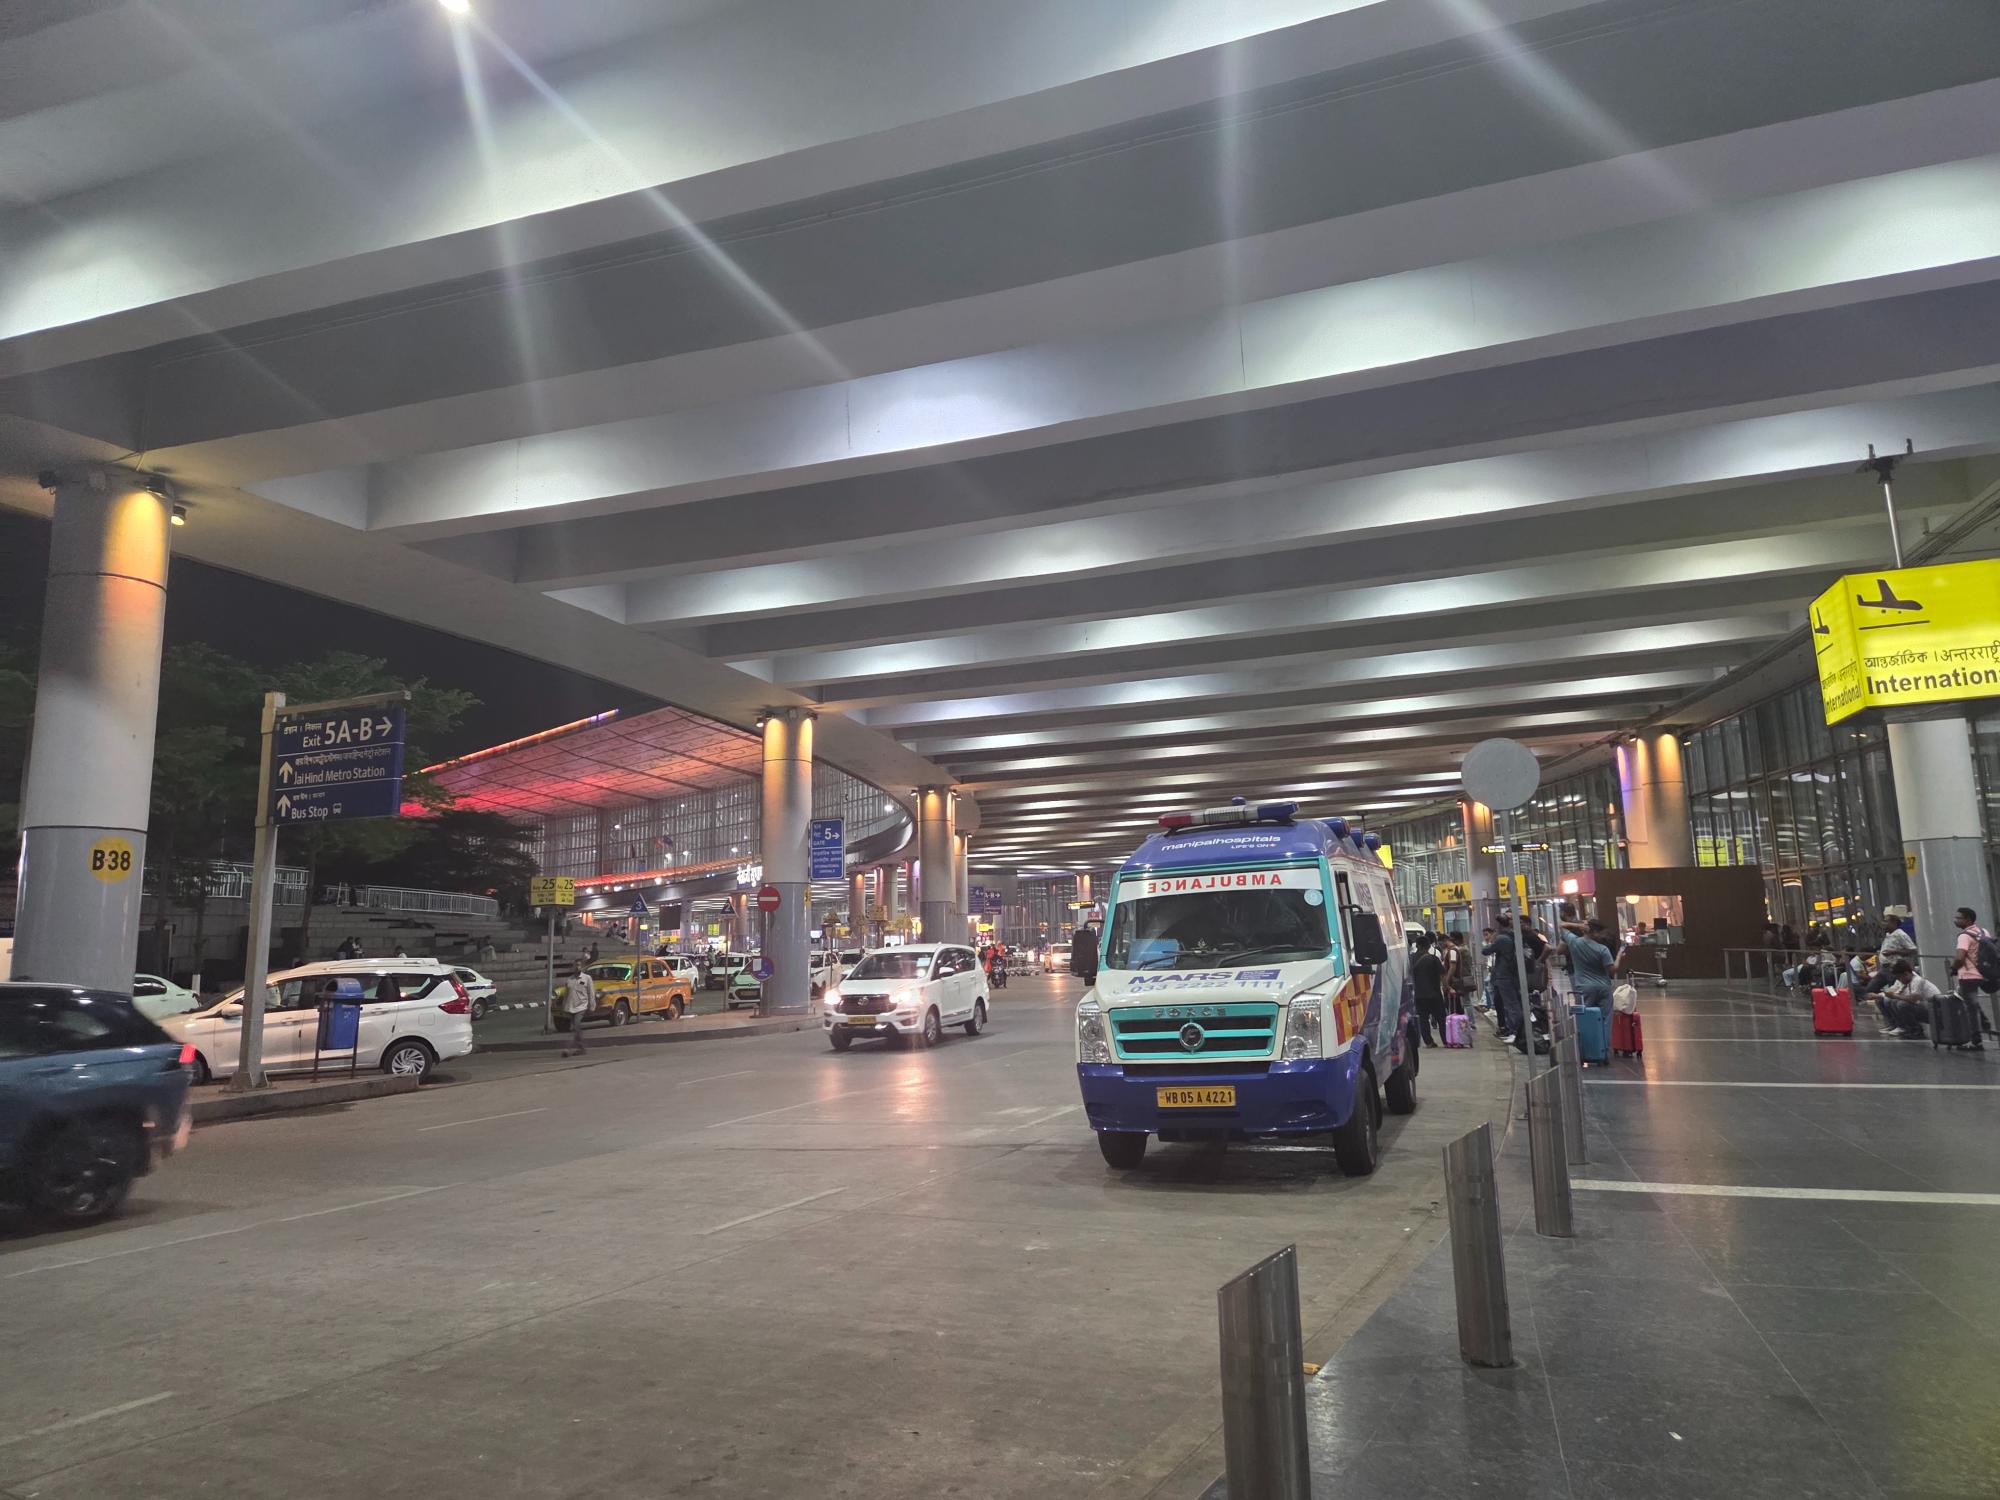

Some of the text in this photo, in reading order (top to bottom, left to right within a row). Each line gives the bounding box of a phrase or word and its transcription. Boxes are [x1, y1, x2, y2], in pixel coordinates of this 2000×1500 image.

[1864, 650, 1928, 669] আন্তর্জাতিক
[1867, 667, 2000, 695] Internation
[302, 718, 373, 748] Exit 5A-B
[294, 766, 385, 785] Jai Hind Metro Station
[291, 806, 329, 820] Bus Stop
[825, 828, 832, 840] 5
[1161, 835, 1281, 852] manipalhospitals
[542, 879, 555, 890] 25
[564, 880, 573, 889] 25
[635, 901, 642, 910] 3
[725, 903, 731, 911] 2
[1128, 972, 1232, 984] MARS
[1130, 981, 1285, 993] 033 2222 1111
[1154, 1007, 1226, 1017] FORCE
[1165, 1090, 1232, 1104] WB 05 A 4221
